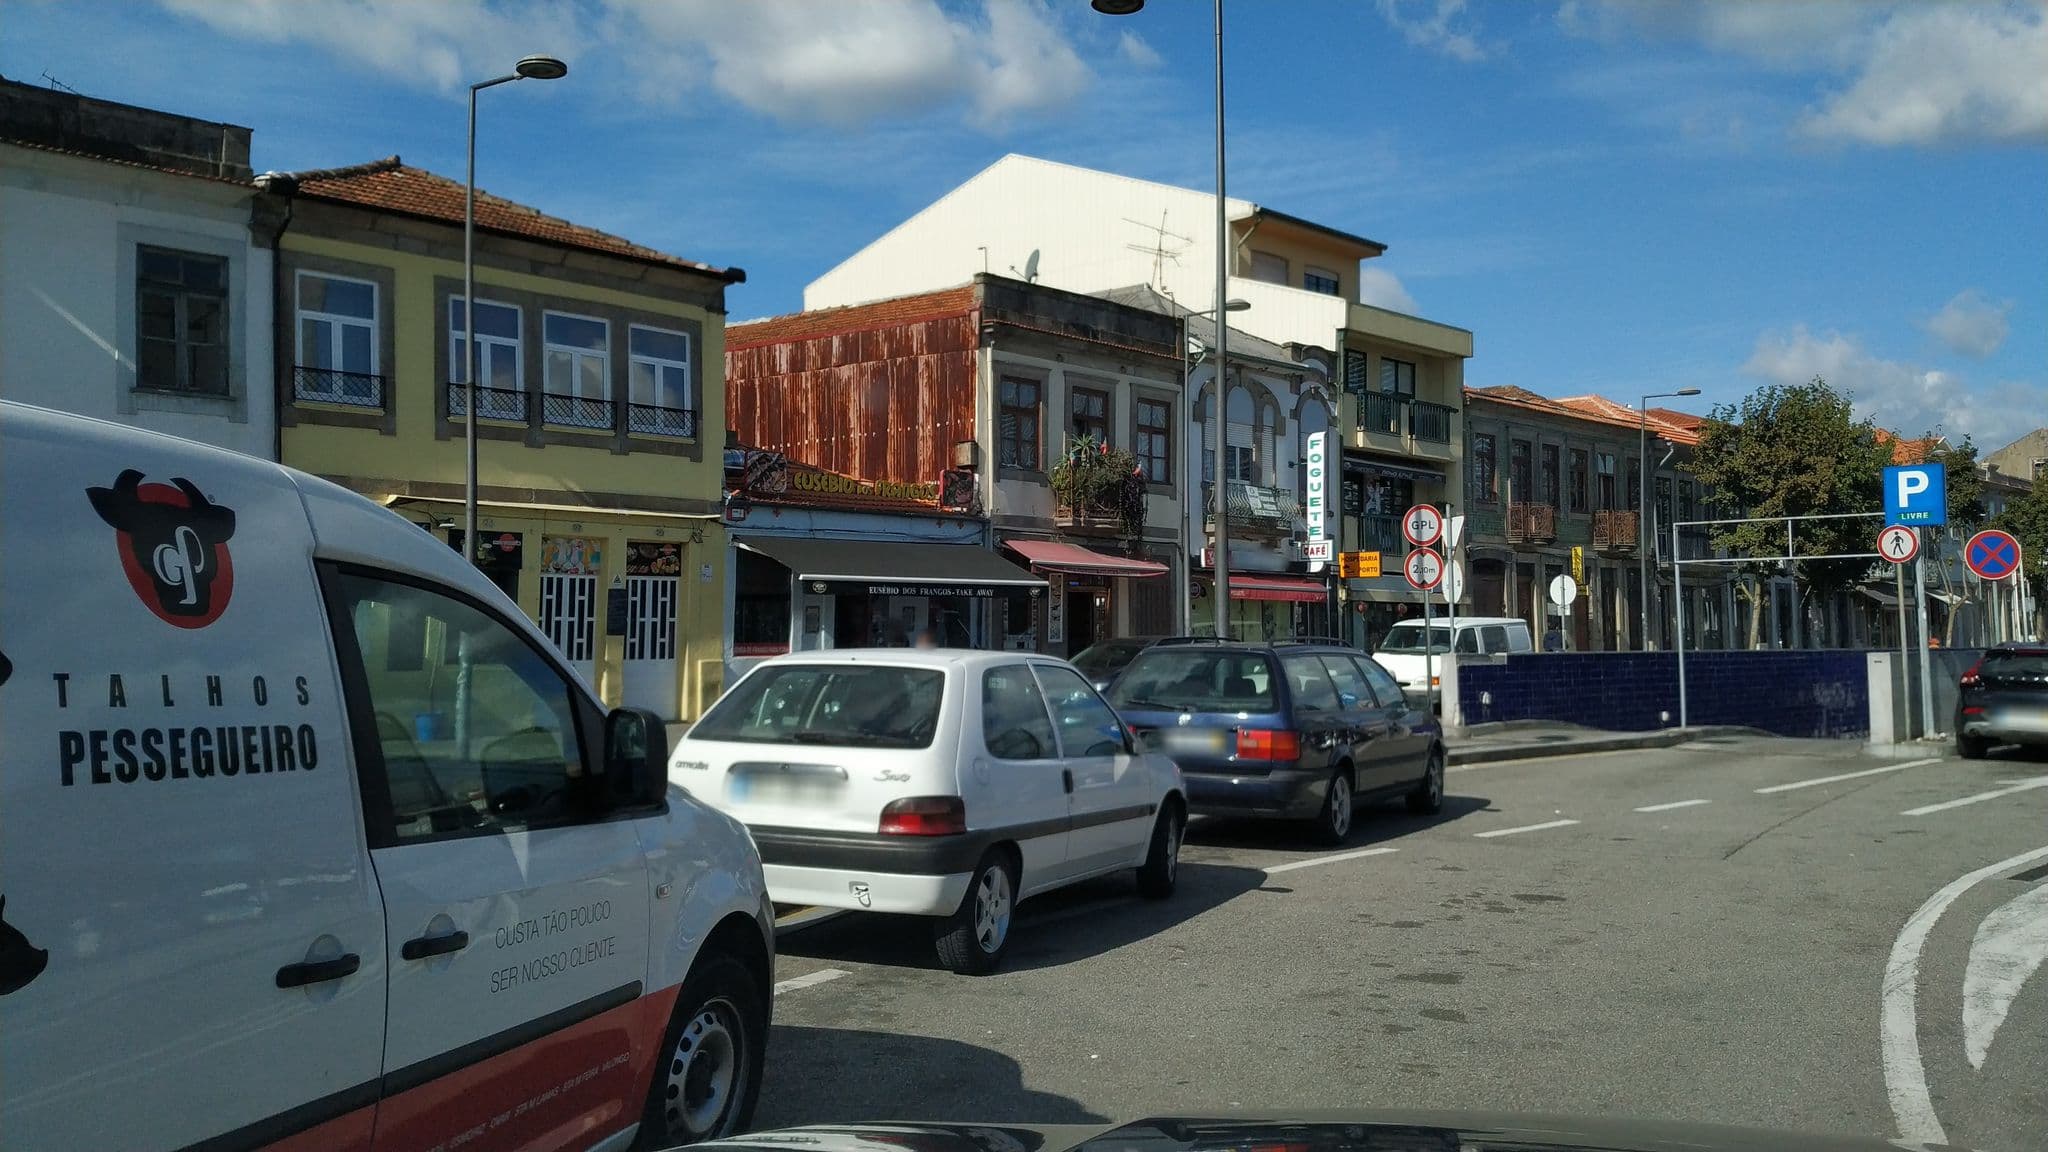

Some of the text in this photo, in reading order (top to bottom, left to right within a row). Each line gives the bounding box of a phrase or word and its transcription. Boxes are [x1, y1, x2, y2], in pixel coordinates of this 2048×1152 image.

[1309, 439, 1322, 536] FOGUETE
[1898, 470, 1929, 507] P
[1411, 520, 1435, 530] GPL
[1901, 512, 1929, 520] LIVRE
[1304, 545, 1326, 556] CAFÉ
[902, 586, 917, 595] DOS
[976, 588, 994, 597] AWAY
[59, 724, 318, 786] PESSEGUEIRO
[495, 900, 611, 949] CUSTA TÃO POUCO
[490, 936, 616, 994] SER NOSSO CLIENTE
